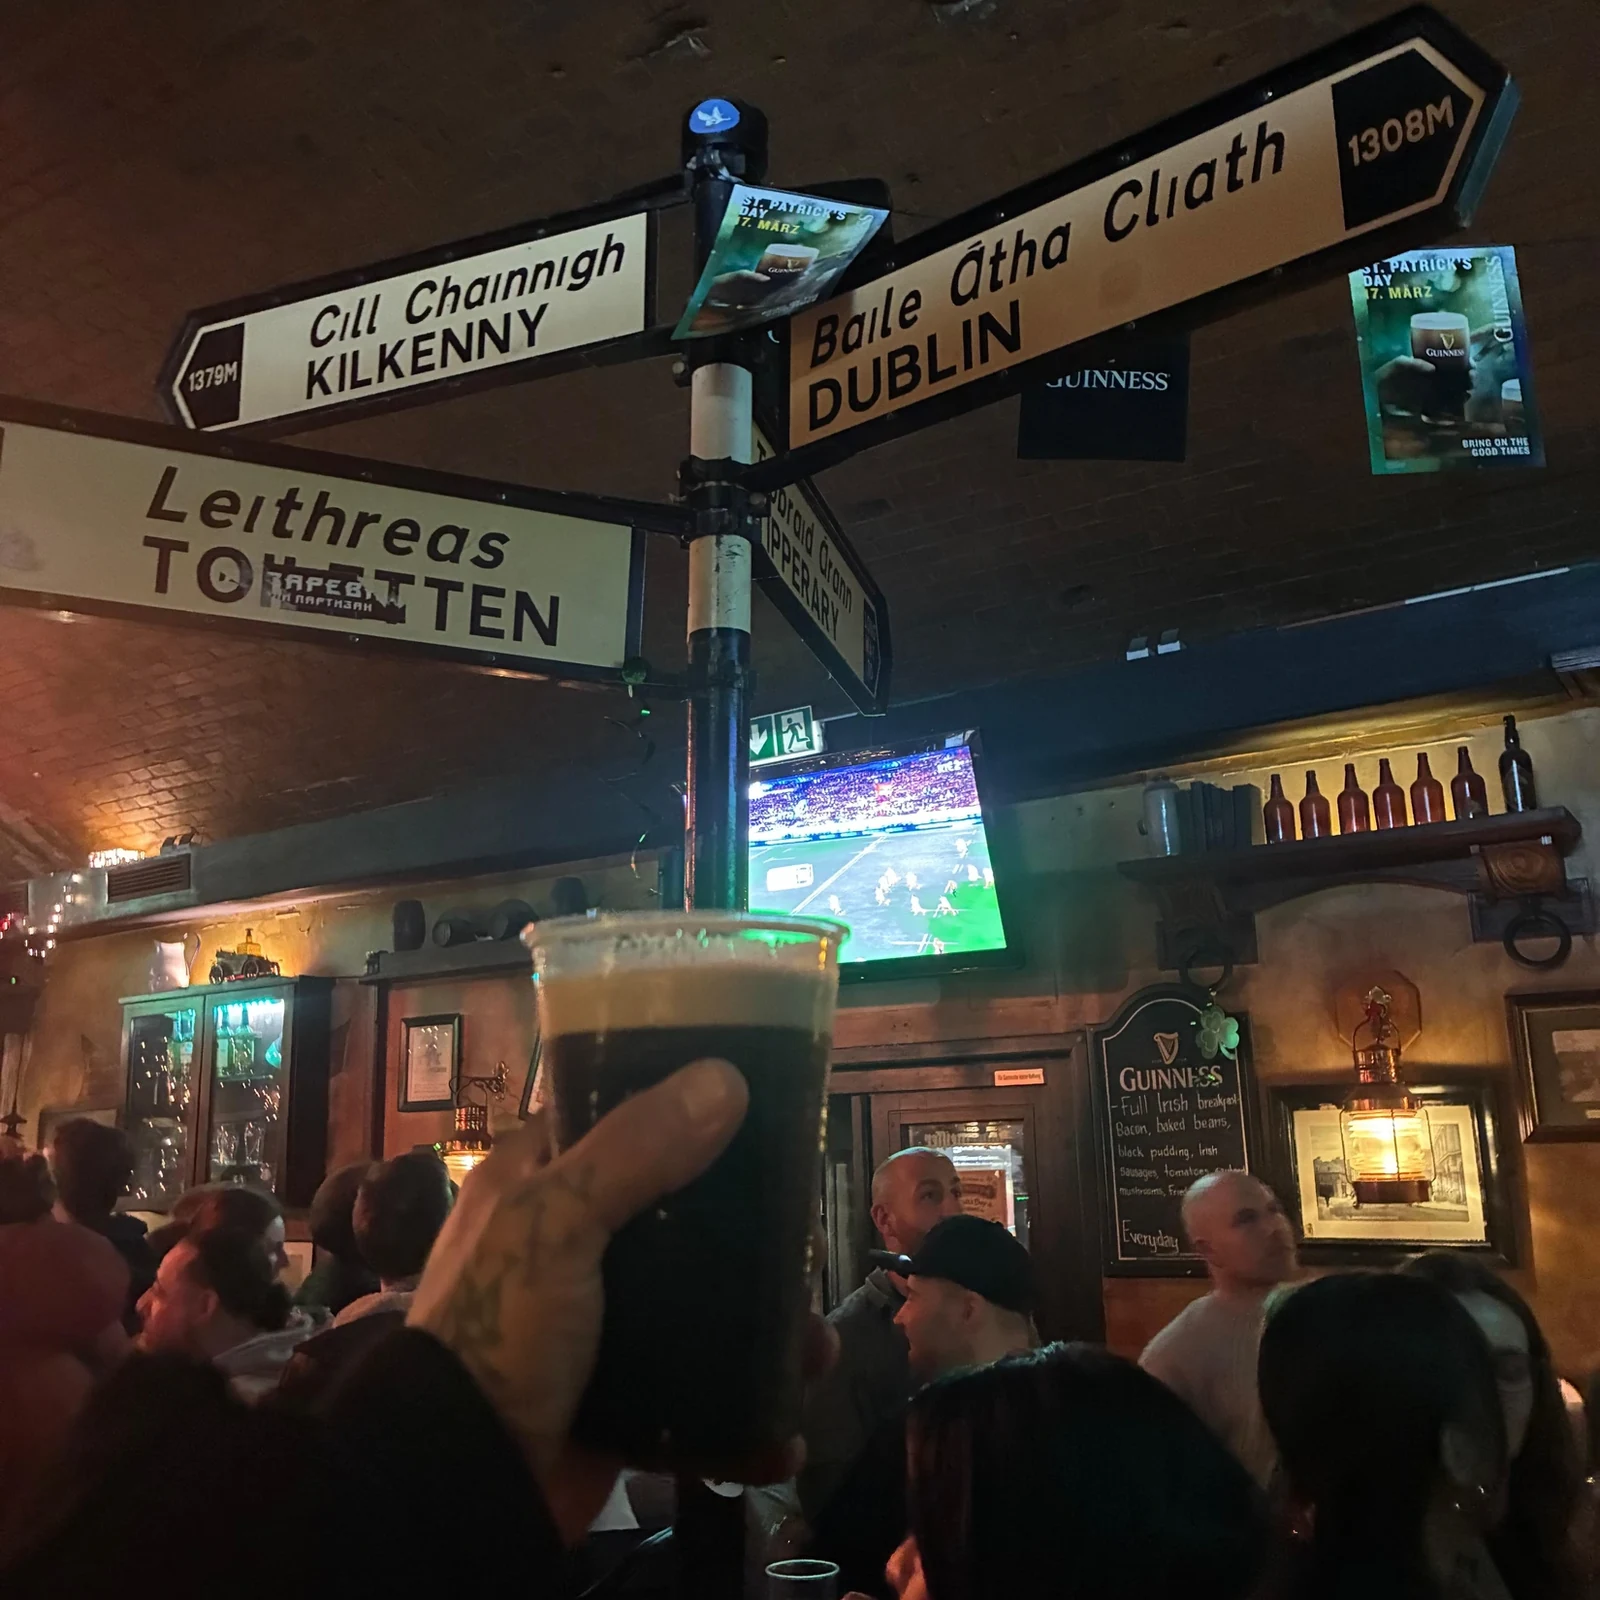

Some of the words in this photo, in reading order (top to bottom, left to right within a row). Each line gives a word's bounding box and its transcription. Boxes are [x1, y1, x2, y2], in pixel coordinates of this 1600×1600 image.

[1347, 94, 1456, 166] 1308M
[738, 205, 769, 219] DAY
[770, 200, 847, 221] PATRICK'S
[757, 219, 801, 235] MÄRZ
[1390, 257, 1473, 274] PATRICK'S
[1363, 274, 1392, 288] DAY
[1389, 285, 1432, 300] MÄRZ
[306, 304, 549, 400] KILKENNY
[1426, 347, 1465, 358] GUINNESS
[188, 361, 239, 392] 1379M
[808, 300, 1024, 432] DUBLIN
[1462, 439, 1492, 449] BRING
[1494, 438, 1509, 448] ON
[1510, 437, 1529, 447] THE
[1472, 447, 1498, 457] GOOD
[1500, 446, 1530, 456] TIMES
[766, 515, 840, 642] IPPERARY
[1119, 1065, 1224, 1092] GUINNESS
[1157, 1092, 1188, 1113] Irish
[1122, 1219, 1180, 1253] Everyday
